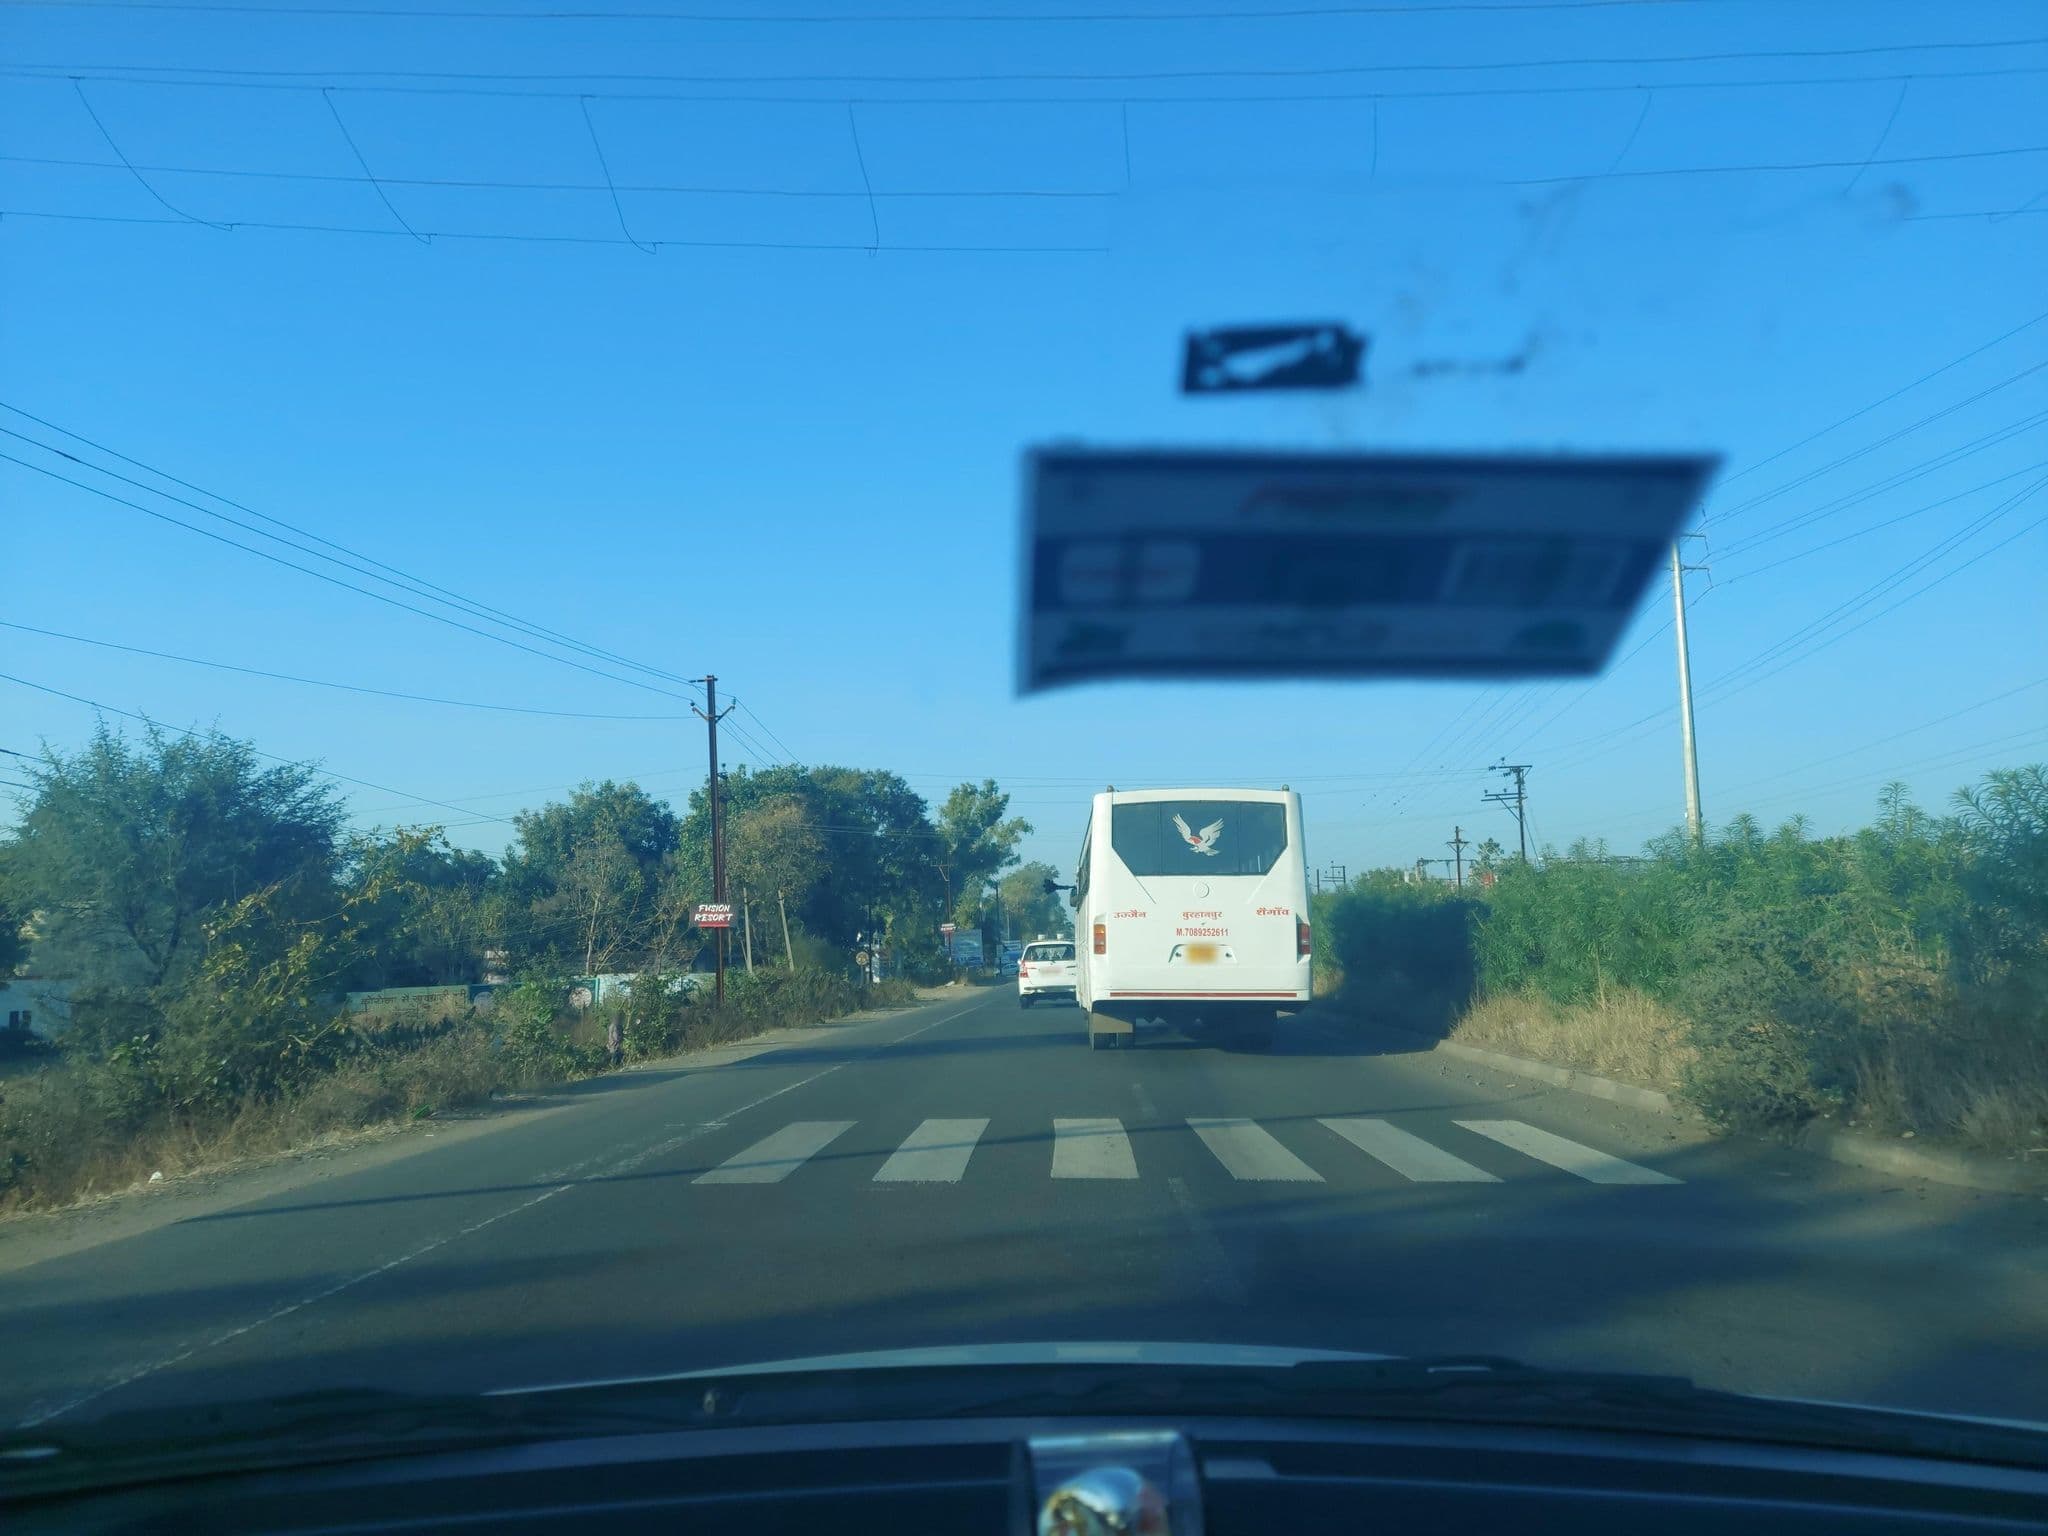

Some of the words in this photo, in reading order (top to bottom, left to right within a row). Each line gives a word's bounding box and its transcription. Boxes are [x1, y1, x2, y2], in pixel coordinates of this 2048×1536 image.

[698, 904, 731, 912] FUSION
[694, 913, 734, 921] RESORT
[1182, 910, 1223, 920] बुरहानपुर
[1175, 927, 1229, 937] M.7089252611
